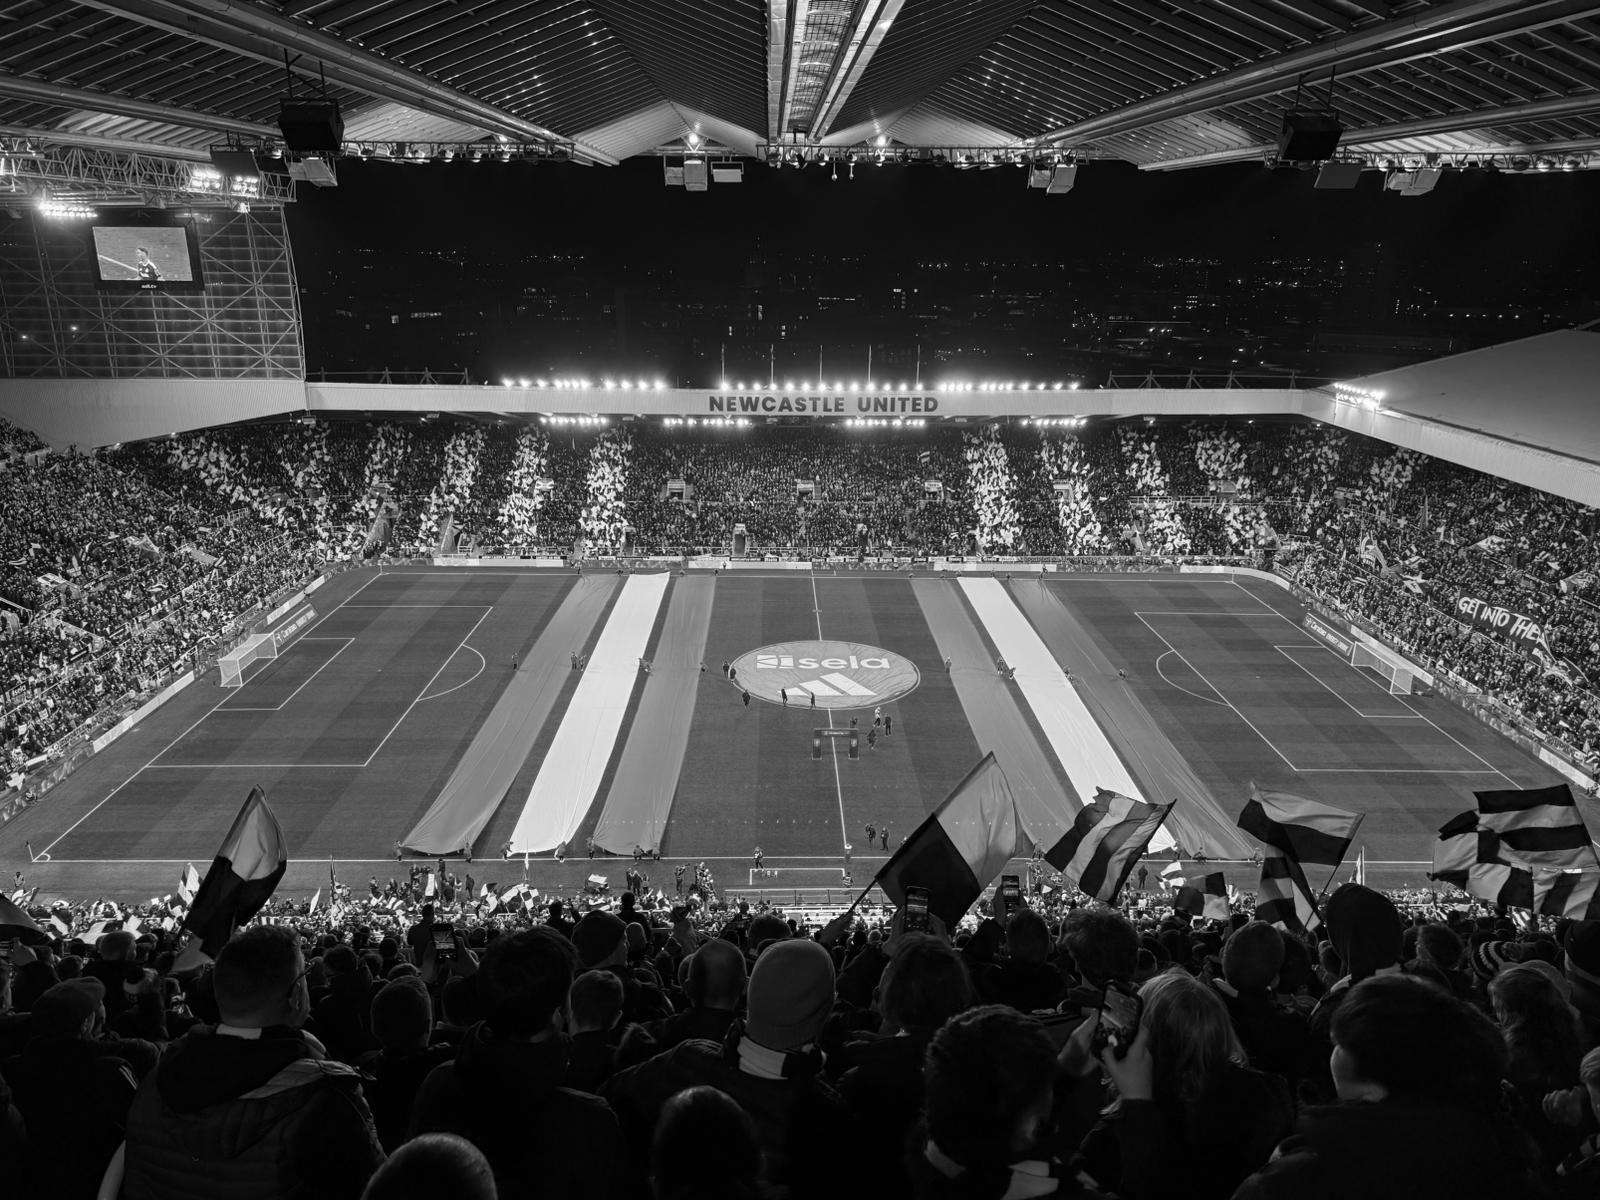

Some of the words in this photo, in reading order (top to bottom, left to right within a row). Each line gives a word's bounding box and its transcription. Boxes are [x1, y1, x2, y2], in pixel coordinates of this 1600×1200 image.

[708, 395, 845, 413] NEWCASTLE
[856, 396, 939, 413] UNITED
[1459, 596, 1487, 620] GET
[1480, 606, 1510, 628] INTO
[798, 655, 891, 670] sela
